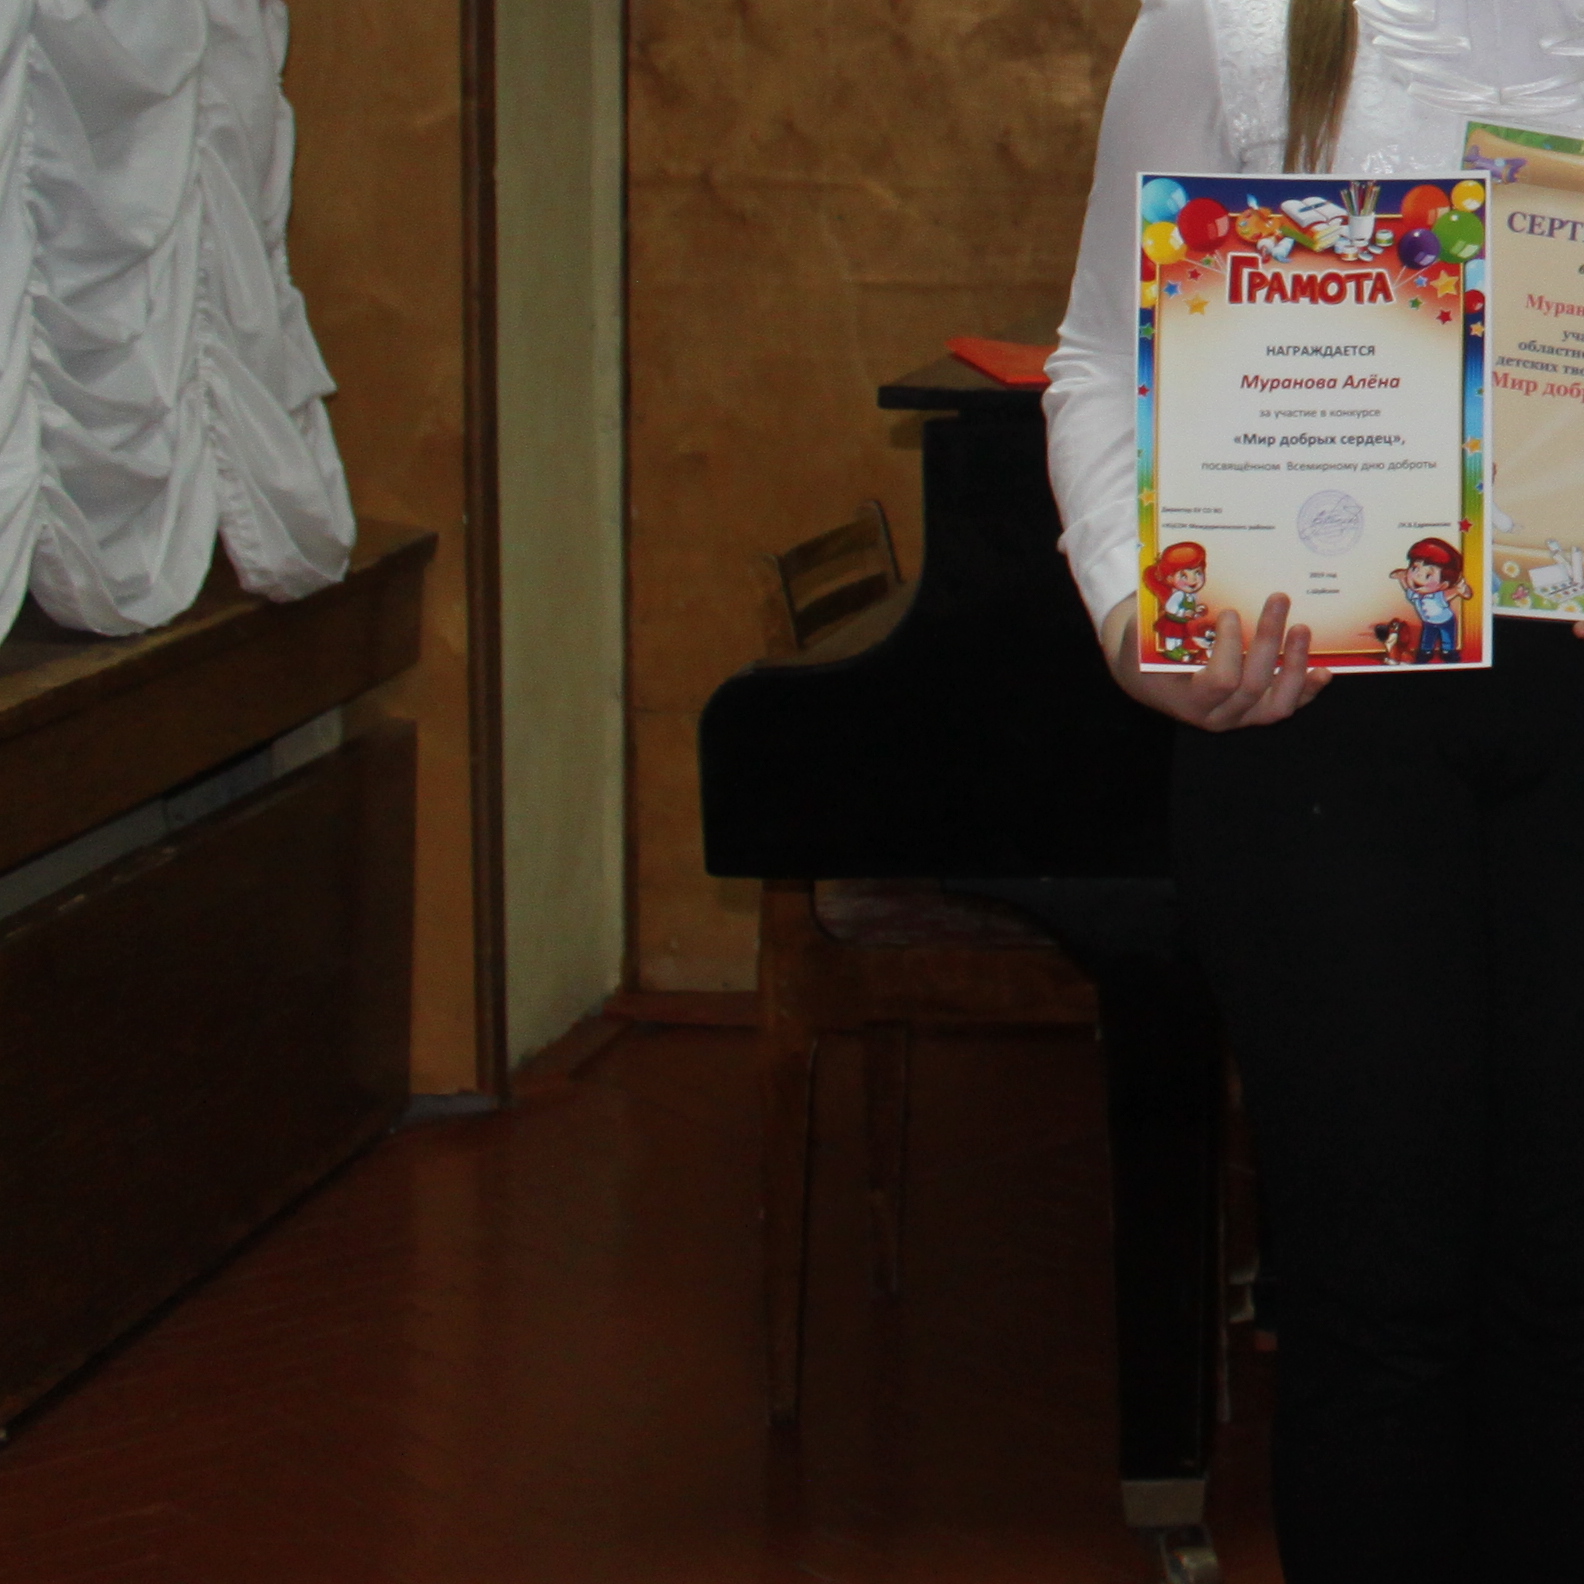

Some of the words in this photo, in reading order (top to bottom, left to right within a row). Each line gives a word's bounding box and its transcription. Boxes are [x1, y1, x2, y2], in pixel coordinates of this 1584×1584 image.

[1228, 253, 1395, 305] ГРАМОТА
[1267, 346, 1375, 357] НАГРАЖДАЕТСЯ
[1496, 355, 1558, 372] детских
[1241, 374, 1336, 392] Муранова
[1343, 374, 1400, 389] Алёна
[1492, 371, 1538, 396] Мир
[1260, 409, 1271, 417] за
[1275, 409, 1317, 420] участие
[1330, 408, 1380, 420] конкурсе
[1234, 433, 1275, 447] «Мир
[1280, 433, 1336, 447] добрых
[1340, 434, 1405, 446] сердец»,
[1202, 461, 1280, 472] посвящённом
[1287, 462, 1357, 472] Всемирному
[1361, 462, 1384, 471] дню
[1388, 460, 1437, 471] доброты
